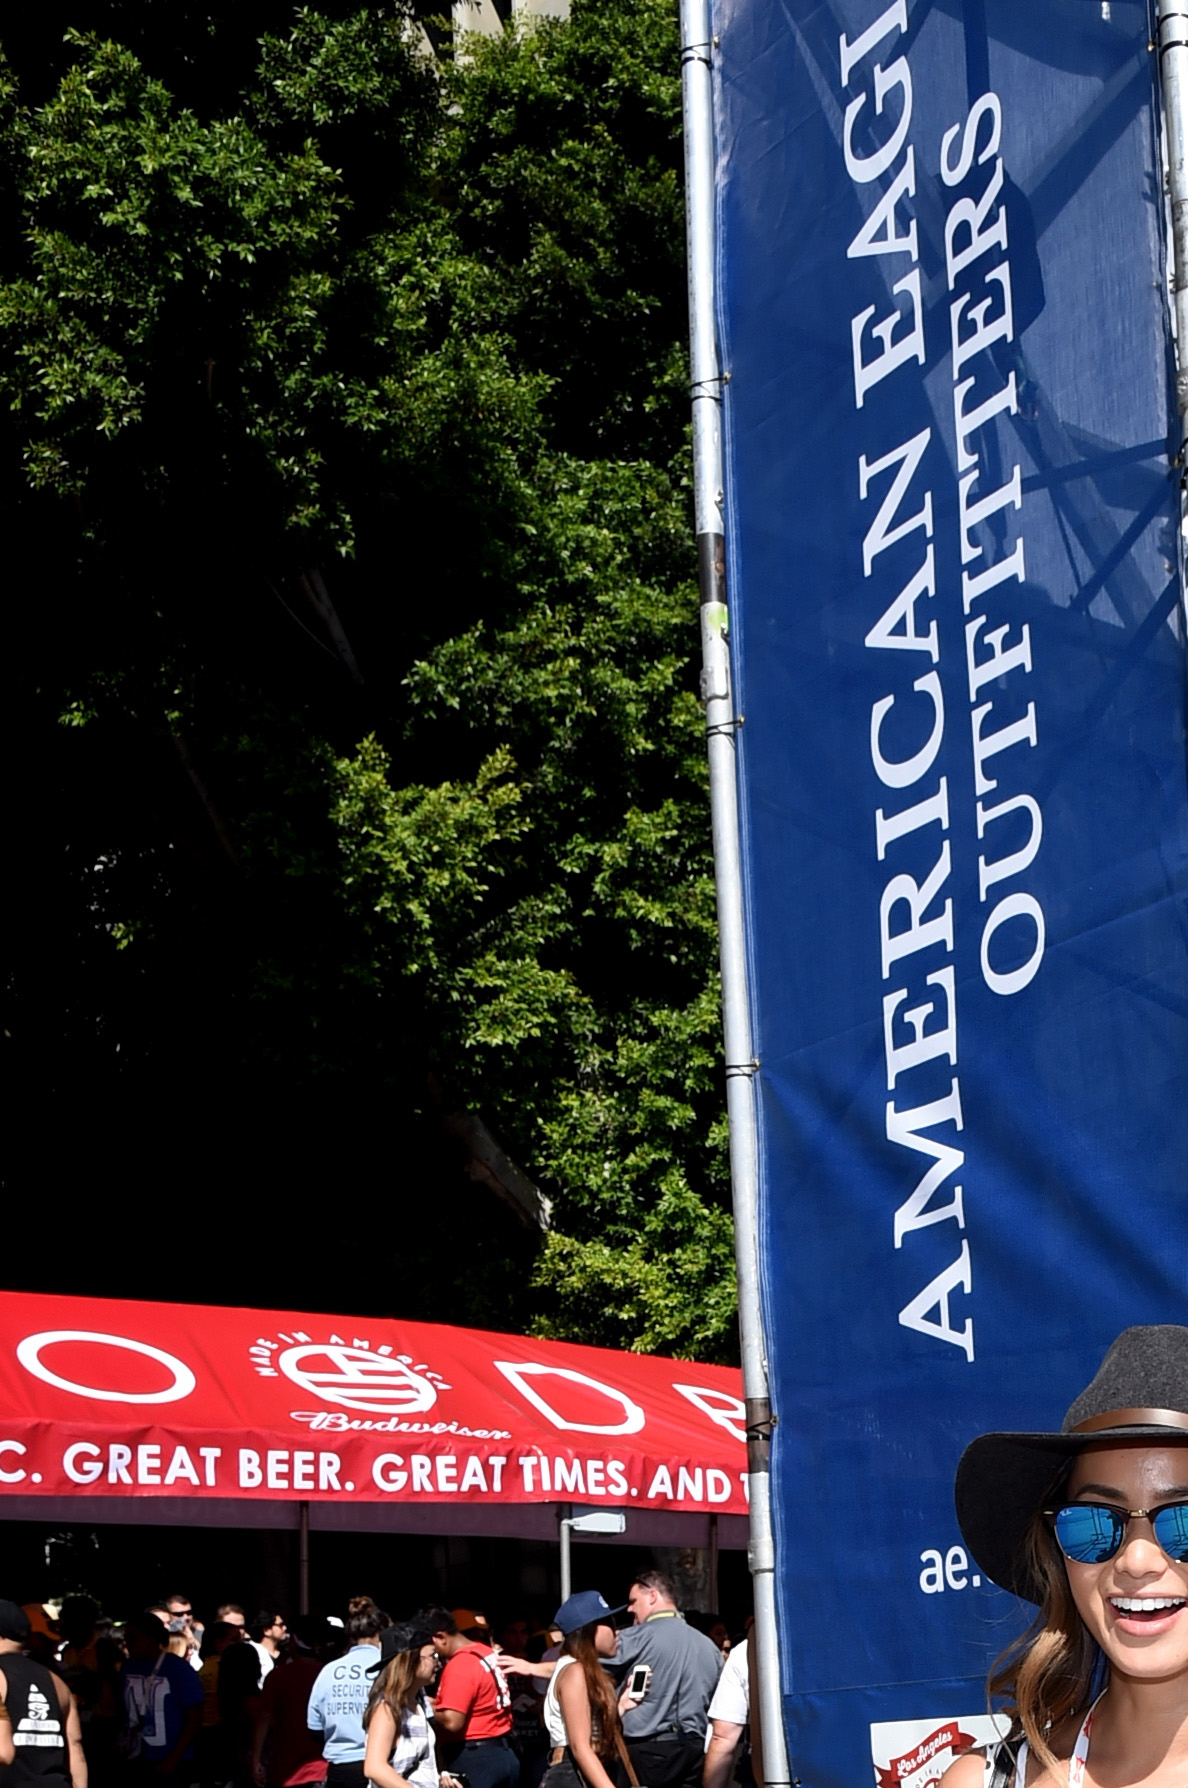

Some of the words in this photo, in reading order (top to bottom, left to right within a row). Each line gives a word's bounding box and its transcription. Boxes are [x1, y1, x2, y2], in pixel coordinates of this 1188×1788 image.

[939, 91, 1045, 996] OUTFITTERS
[859, 427, 975, 1363] AMERICAN
[277, 1331, 313, 1344] IN
[289, 1410, 512, 1440] Budweiser
[62, 1441, 222, 1487] GREAT
[238, 1448, 355, 1492] BEER.
[371, 1452, 507, 1493] GREAT
[518, 1455, 639, 1497] TIMES.
[646, 1464, 733, 1504] AND
[919, 1545, 995, 1595] ae.
[332, 1684, 371, 1698] SECURIT
[896, 1758, 917, 1777] Los
[917, 1730, 953, 1764] Angeles
